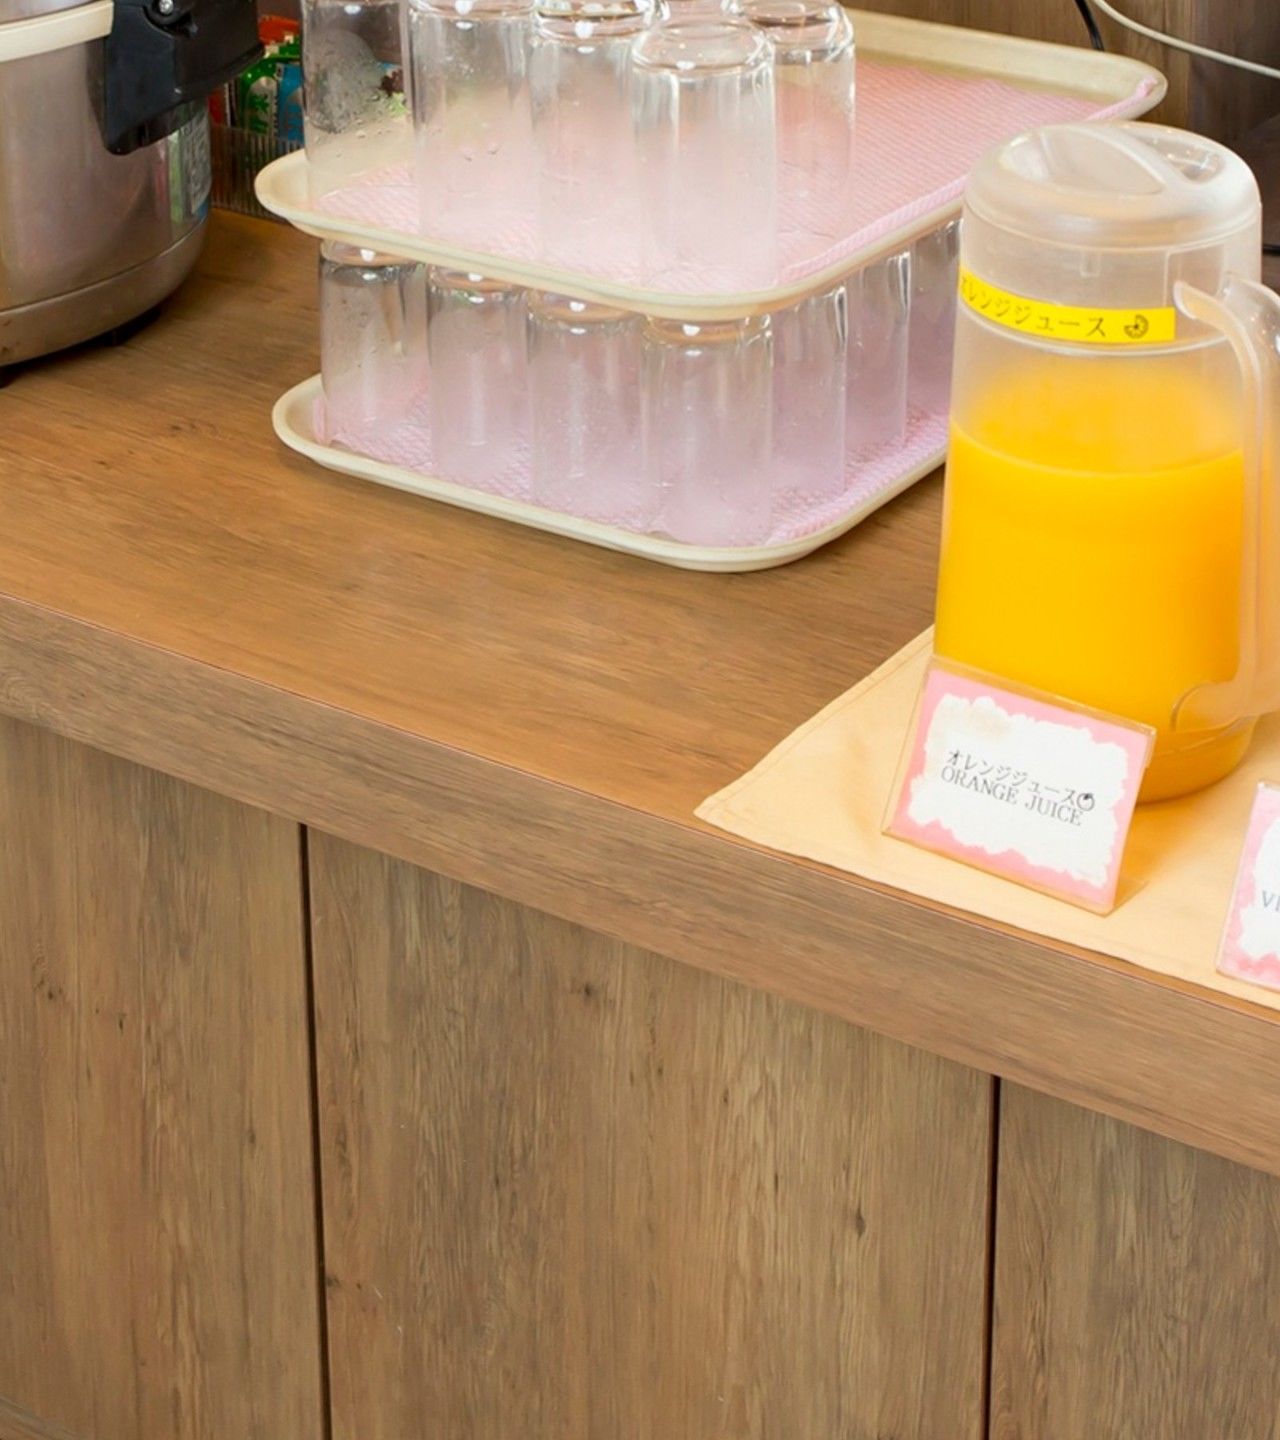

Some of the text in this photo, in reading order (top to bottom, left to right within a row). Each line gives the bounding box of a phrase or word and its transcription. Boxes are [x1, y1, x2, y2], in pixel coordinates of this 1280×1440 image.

[940, 765, 1086, 827] ORANGE JUICE
[947, 749, 1076, 806] オレンジジュース
